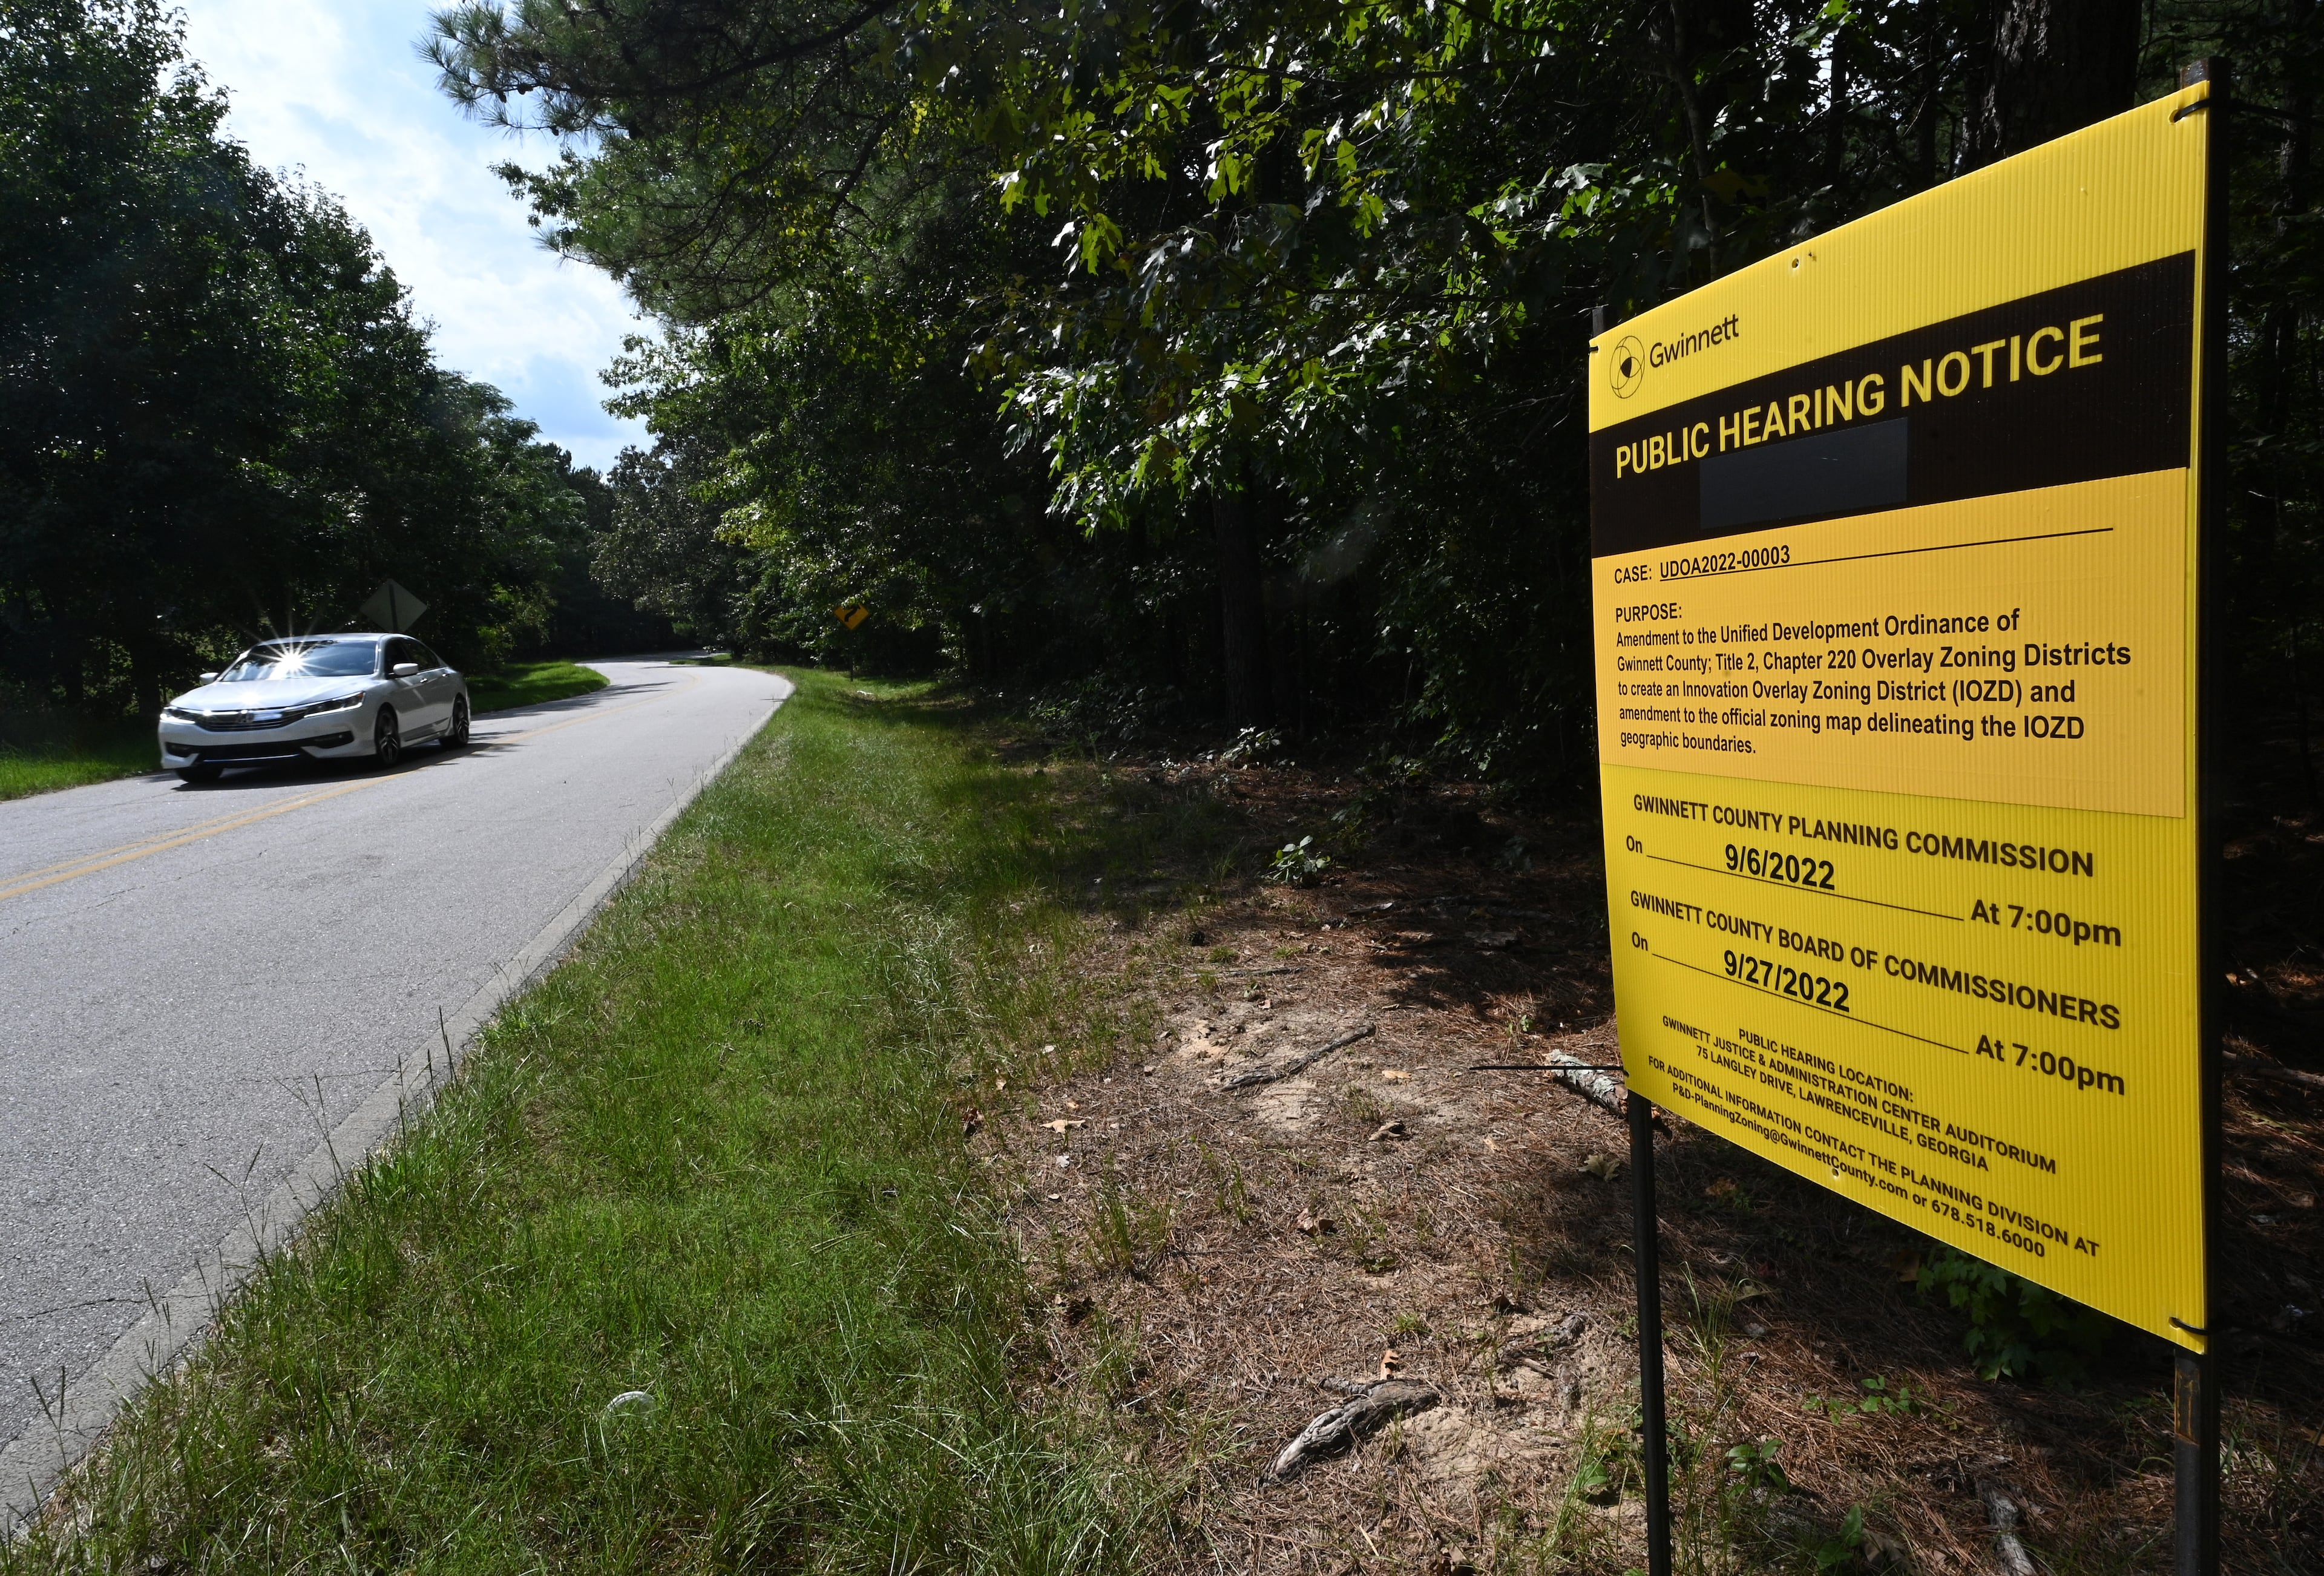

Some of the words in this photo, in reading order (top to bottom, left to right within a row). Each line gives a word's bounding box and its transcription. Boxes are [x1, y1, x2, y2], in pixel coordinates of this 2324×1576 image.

[1650, 313, 1739, 369] Gwinnett
[1616, 422, 1709, 479] PUBLIC
[1719, 372, 1884, 452] HEARING
[1902, 314, 2103, 407] NOTICE
[1615, 565, 1652, 583] CASE:
[1660, 545, 1790, 578] UDOA2022-00003
[1616, 603, 1682, 622] PURPOSE:
[1617, 629, 1679, 646] Amendment
[1682, 628, 1694, 644] to
[1698, 627, 1716, 643] the
[1721, 624, 1767, 643] Unified
[1773, 618, 1879, 643] Development
[1885, 614, 1989, 636] Ordinance
[1997, 608, 2020, 631] of
[1618, 656, 1663, 671] Gwinnett
[1667, 655, 1711, 674] County;
[1716, 653, 1742, 670] Title
[1747, 653, 1758, 672] 2,
[1764, 652, 1822, 674] Chapter
[1828, 649, 1856, 669] 220
[1862, 648, 1933, 673] Overlay
[1940, 646, 2015, 672] Zoning
[2024, 642, 2131, 666] Districts
[1618, 681, 1627, 695] to
[1631, 682, 1662, 696] create
[1666, 683, 1679, 697] an
[1683, 681, 1747, 698] Innovation
[1753, 680, 1807, 703] Overlay
[1813, 681, 1870, 704] Zoning
[1877, 680, 1945, 701] District
[1953, 680, 2021, 708] (IOZD)
[2030, 680, 2075, 702] and
[1620, 706, 1680, 722] amendment
[1684, 708, 1695, 723] to
[1699, 708, 1718, 724] the
[1722, 708, 1765, 726] official
[1770, 711, 1820, 734] zoning
[1827, 715, 1861, 735] map
[1868, 712, 1974, 741] delineating
[1981, 715, 2015, 737] the
[2024, 715, 2084, 739] IOZD
[1621, 730, 1679, 750] geographic
[1683, 732, 1756, 754] boundaries.
[1634, 794, 1708, 821] GWINNETT
[1713, 806, 1782, 833] COUNTY
[1789, 816, 1898, 850] PLANNING
[1906, 831, 2093, 876] COMMISSION
[1626, 835, 1643, 853] On
[1725, 844, 1834, 890] 9/6/2022
[1971, 899, 2000, 925] At
[2007, 905, 2121, 947] 7:00pm
[1631, 890, 1702, 924] GWINNETT
[1707, 911, 1773, 943] COUNTY
[1779, 929, 1843, 962] BOARD
[1851, 947, 1877, 970] OF
[1885, 955, 2119, 1029] COMMISSIONERS
[1632, 932, 1647, 951] On
[1724, 950, 1850, 1012] 9/27/2022
[1975, 1035, 2004, 1062] At
[2012, 1043, 2125, 1095] 7:00pm
[1663, 1016, 1710, 1043] GWINNETT
[1713, 1036, 1755, 1062] JUSTICE
[1759, 1054, 1766, 1066] &
[1769, 1059, 1877, 1109] ADMINISTRATION
[1882, 1100, 1940, 1132] CENTER
[1946, 1124, 2055, 1174] AUDITORIUM
[1739, 1029, 1777, 1052] PUBLIC
[1781, 1044, 1835, 1074] HEARING
[1839, 1065, 1914, 1102] LOCATION:
[1696, 1046, 1708, 1059] 75
[1711, 1051, 1756, 1079] LANGLEY
[1761, 1074, 1796, 1098] DRIVE,
[1799, 1091, 1912, 1144] LAWRENCEVILLE,
[1917, 1133, 1989, 1172] GEORGIA
[1649, 1056, 1665, 1072] FOR
[1667, 1065, 1722, 1098] ADDITIONAL
[1726, 1091, 1801, 1134] INFORMATION
[1805, 1126, 1865, 1161] CONTACT
[1869, 1153, 1896, 1175] THE
[1902, 1166, 1983, 1210] PLANNING
[1989, 1201, 2067, 1246] DIVISION
[2075, 1237, 2099, 1256] AT
[1673, 1082, 1908, 1199] P&D-PlanningZoning@GwinnettCounty.com
[1912, 1192, 1926, 1207] or
[1932, 1200, 2044, 1257] 678.518.6000
